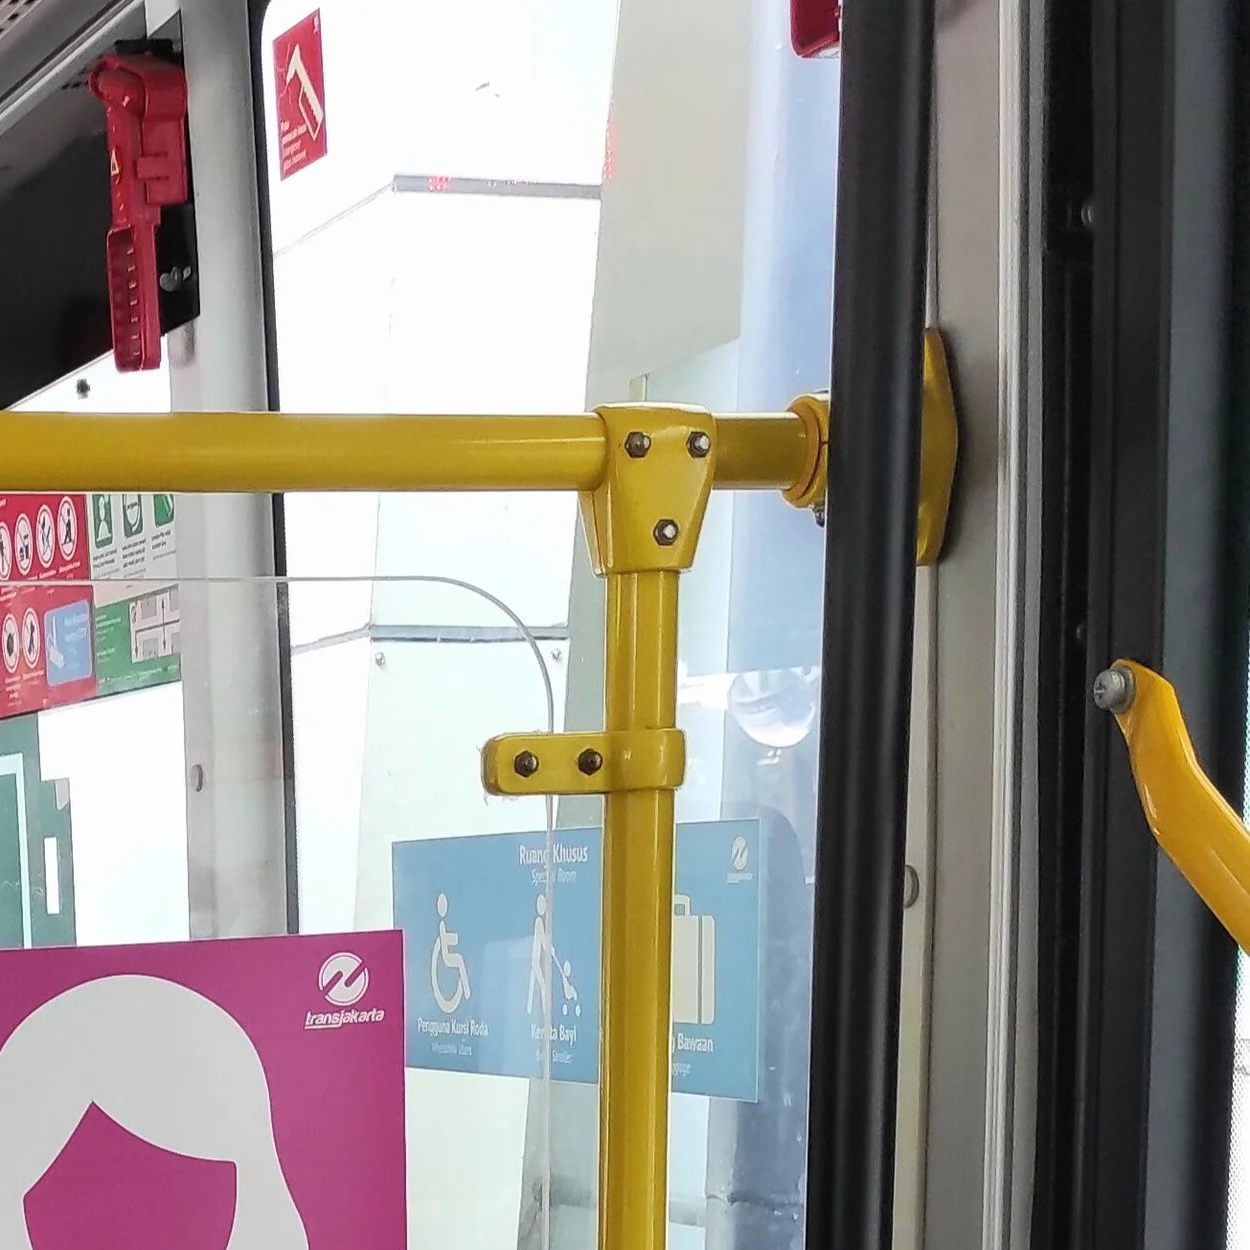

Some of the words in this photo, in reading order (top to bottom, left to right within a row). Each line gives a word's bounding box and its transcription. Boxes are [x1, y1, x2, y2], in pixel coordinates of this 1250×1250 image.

[553, 843, 589, 864] Khusus
[304, 1007, 386, 1030] transjakarta
[677, 1033, 714, 1053] Bawaan
